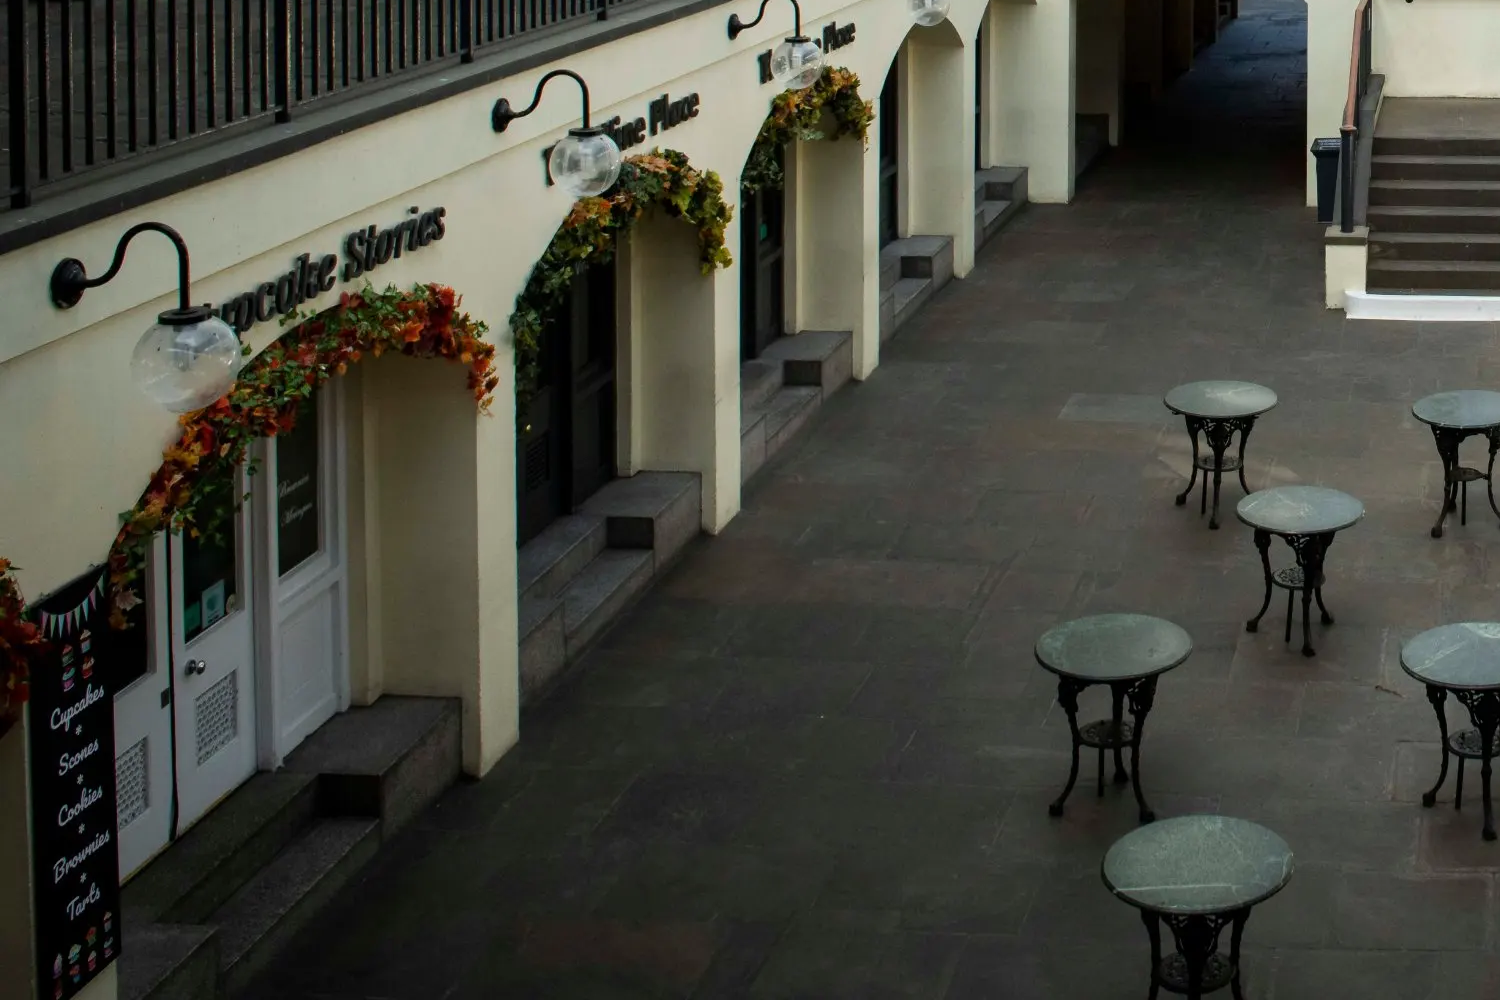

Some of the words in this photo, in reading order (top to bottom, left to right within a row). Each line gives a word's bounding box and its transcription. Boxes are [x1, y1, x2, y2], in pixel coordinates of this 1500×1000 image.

[649, 92, 700, 136] Place
[342, 206, 447, 283] Stories
[50, 683, 105, 733] Cupcakes
[58, 738, 100, 776] Scones
[58, 785, 103, 827] Cookies
[53, 829, 111, 884] Brownies
[66, 881, 101, 921] Tarts
